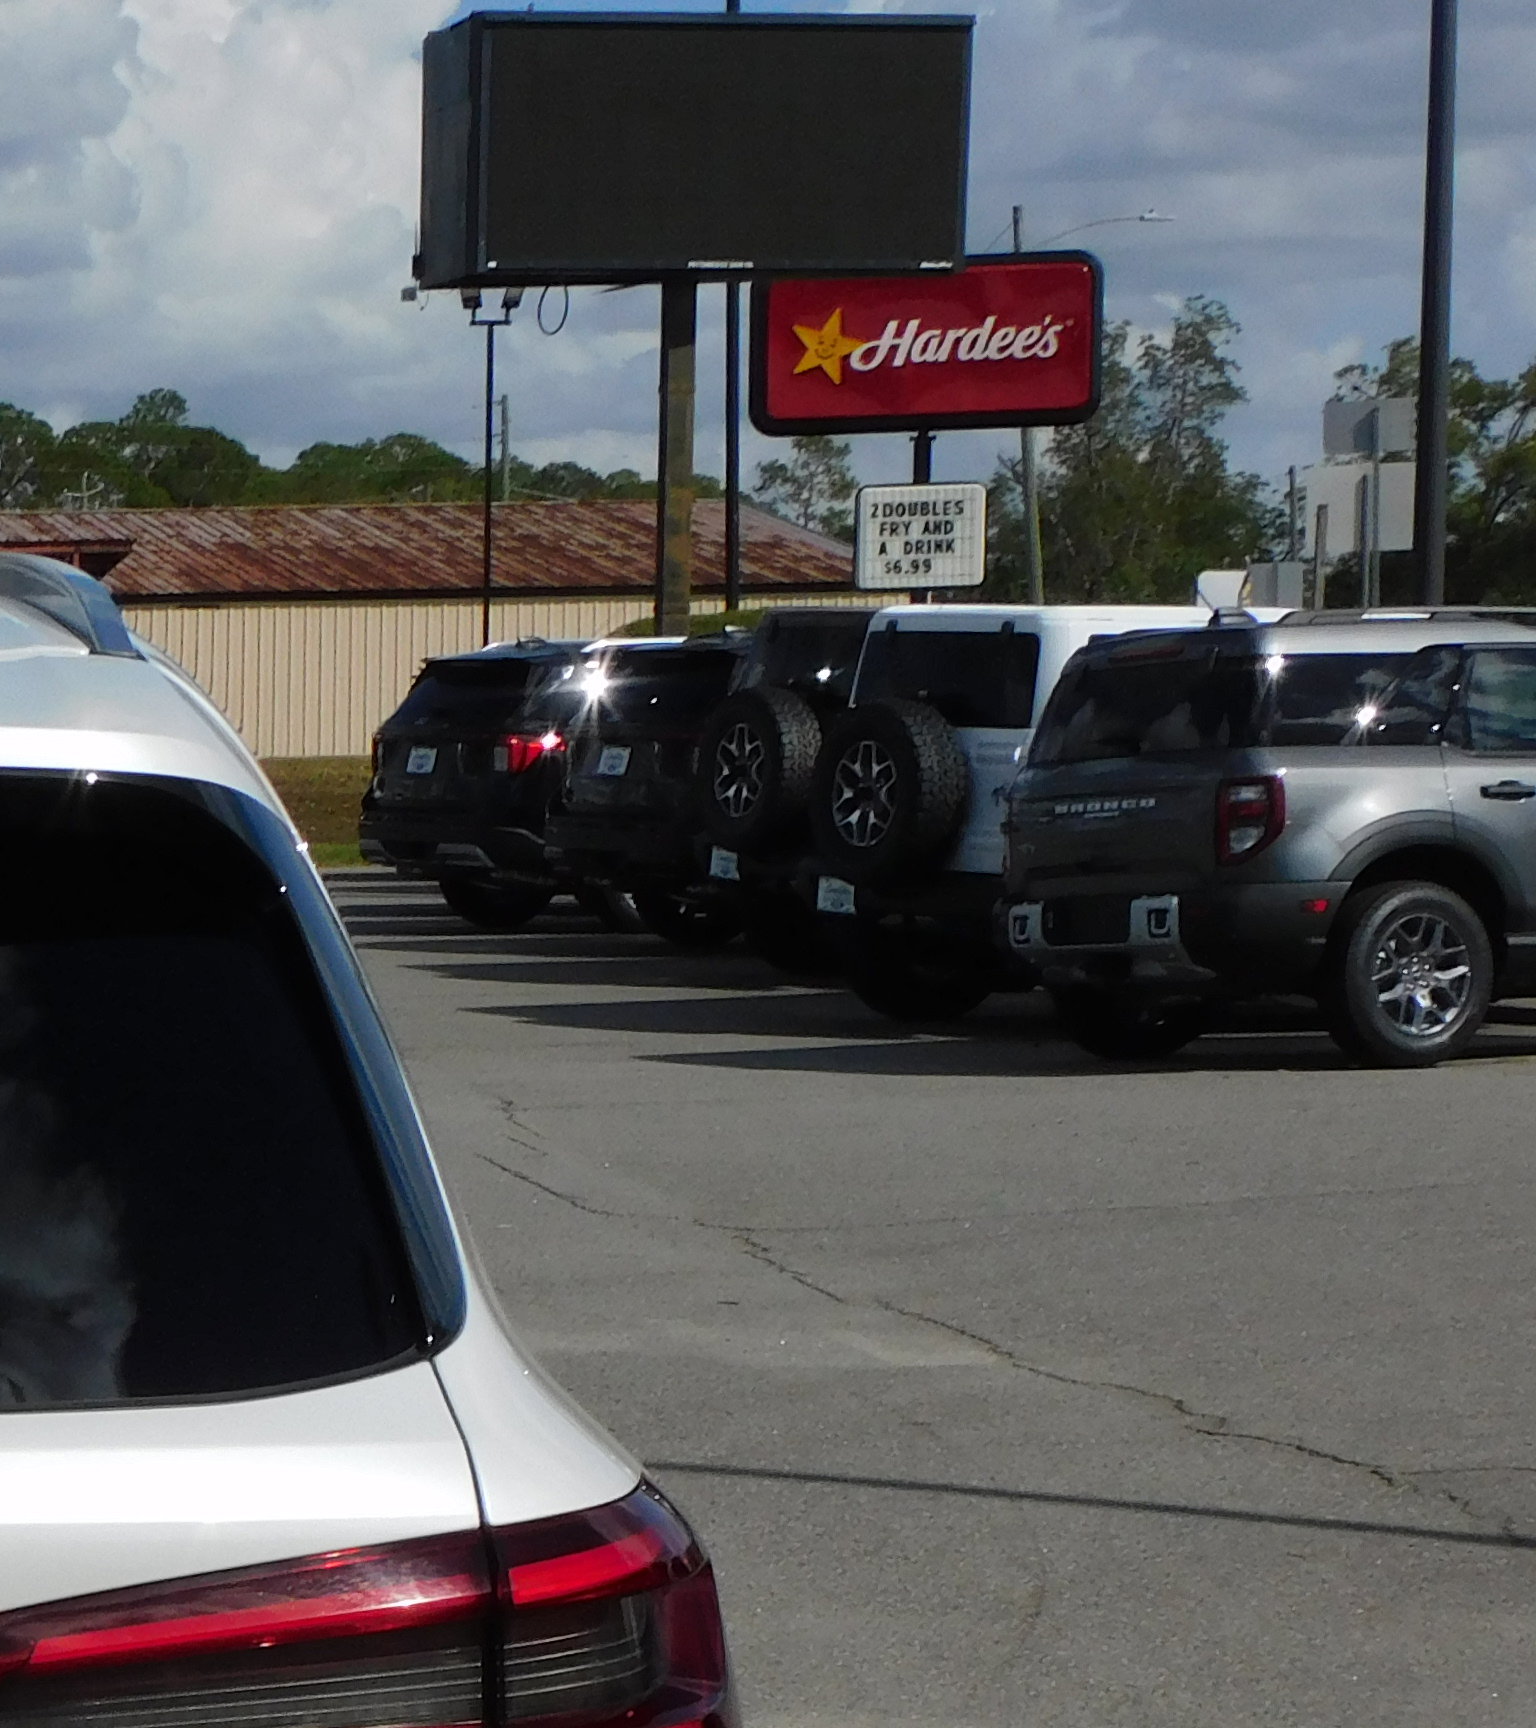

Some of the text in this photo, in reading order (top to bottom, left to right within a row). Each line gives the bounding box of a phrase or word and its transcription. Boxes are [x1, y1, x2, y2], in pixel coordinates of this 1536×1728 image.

[849, 314, 1064, 372] Hardee's
[879, 521, 954, 536] FRY AND
[878, 540, 955, 555] A DRINK
[884, 559, 932, 574] $6.99
